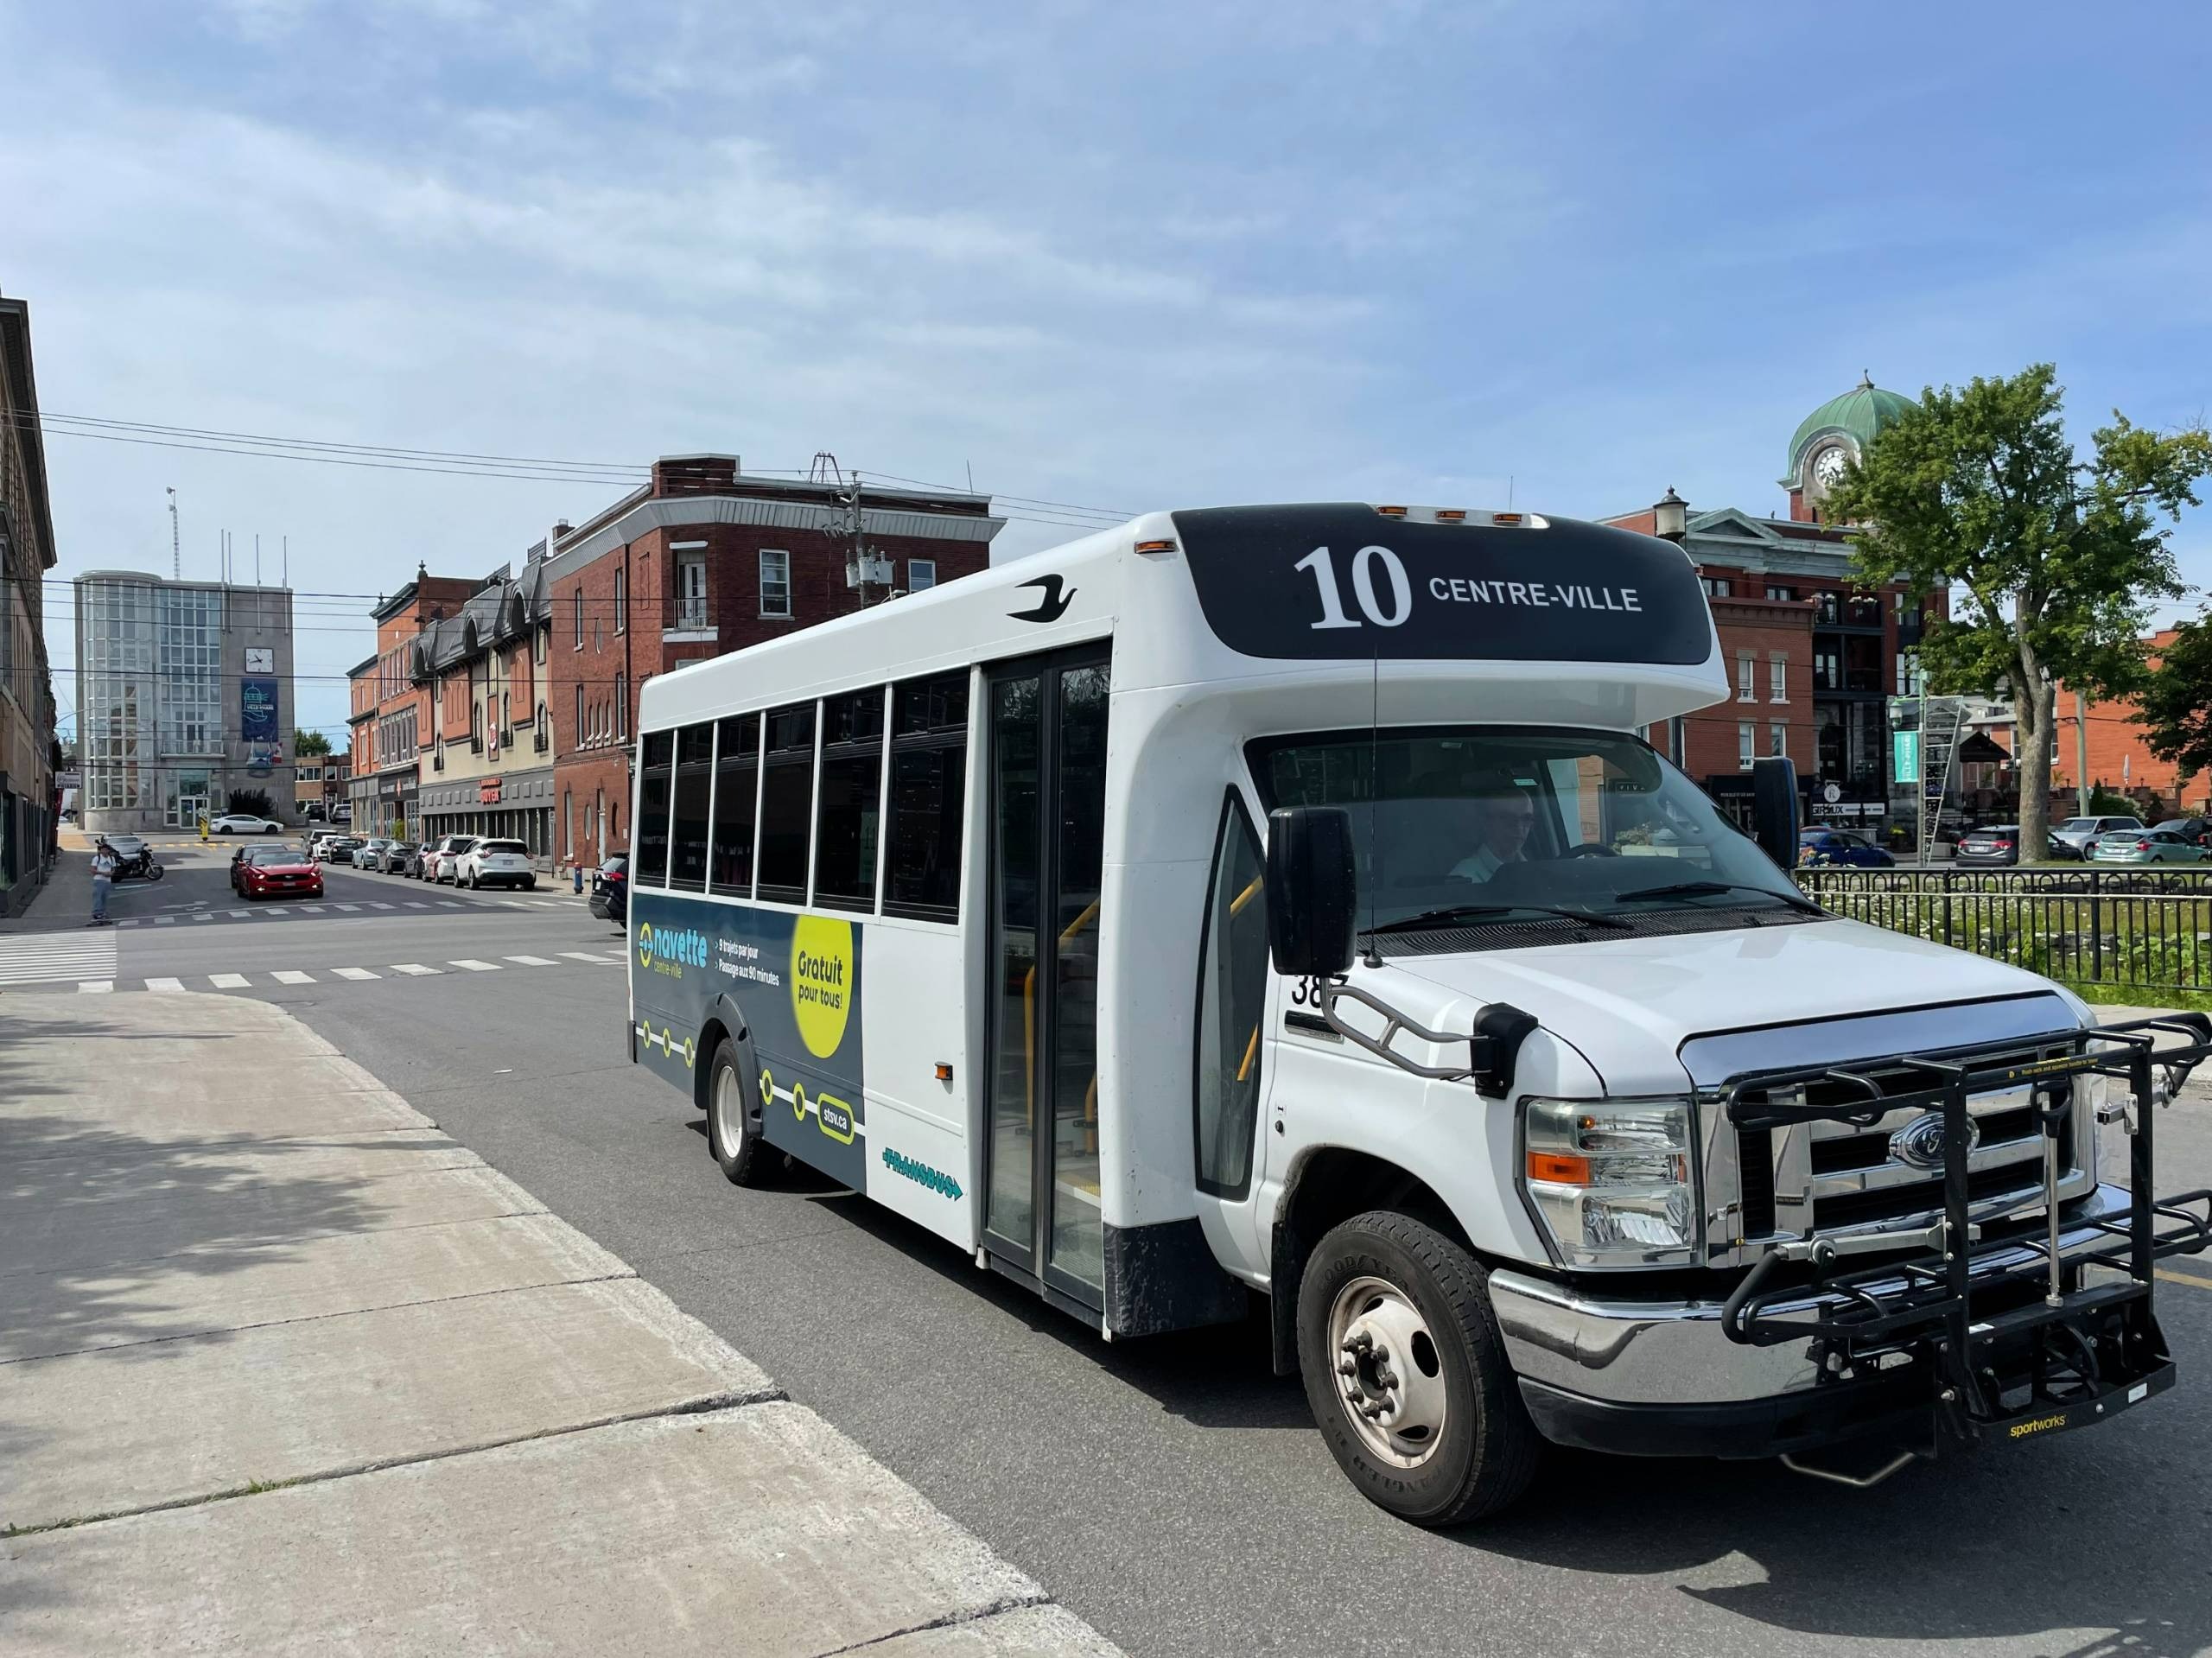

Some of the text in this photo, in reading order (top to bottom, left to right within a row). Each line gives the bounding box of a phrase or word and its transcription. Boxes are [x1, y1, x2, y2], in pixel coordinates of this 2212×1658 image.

[1294, 544, 1643, 631] 10 CENTRE-VILLE
[654, 927, 708, 969] navette
[719, 938, 759, 962] 9 trajets par jour
[653, 960, 682, 979] centre-ville
[719, 959, 779, 987] Passage aux 90 minutes
[798, 950, 842, 986] Gratuit
[798, 984, 842, 1009] pour tous!
[823, 1106, 848, 1130] stsv.ca
[884, 1147, 956, 1199] TRANSBUS
[2010, 1414, 2067, 1438] sportworks
